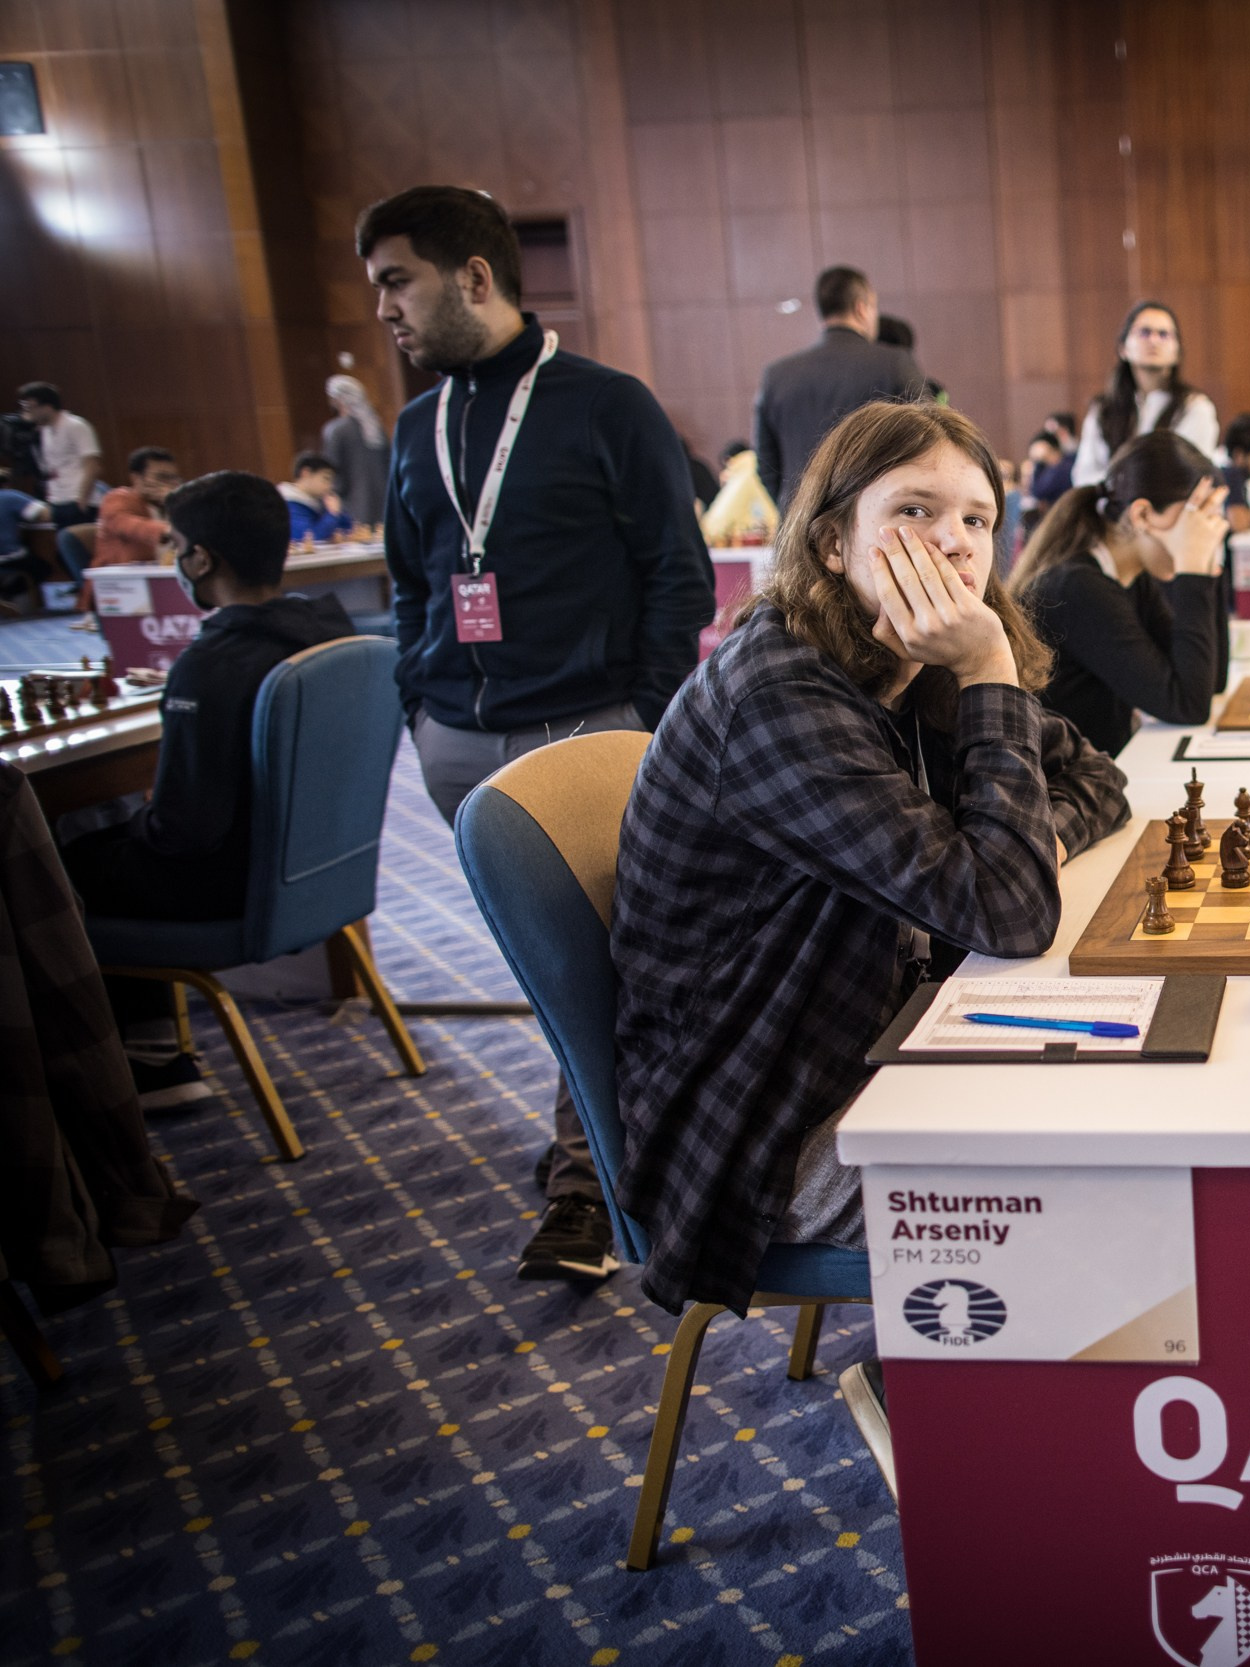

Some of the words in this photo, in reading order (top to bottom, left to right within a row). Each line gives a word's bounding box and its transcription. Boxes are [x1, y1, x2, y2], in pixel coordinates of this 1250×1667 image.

[887, 1190, 1042, 1214] Shturman
[891, 1218, 1010, 1246] Arseniy
[892, 1248, 923, 1264] FM
[930, 1248, 981, 1265] 2350
[943, 1335, 970, 1347] FIDE
[1163, 1339, 1187, 1354] 96
[1191, 1564, 1219, 1576] QCA
